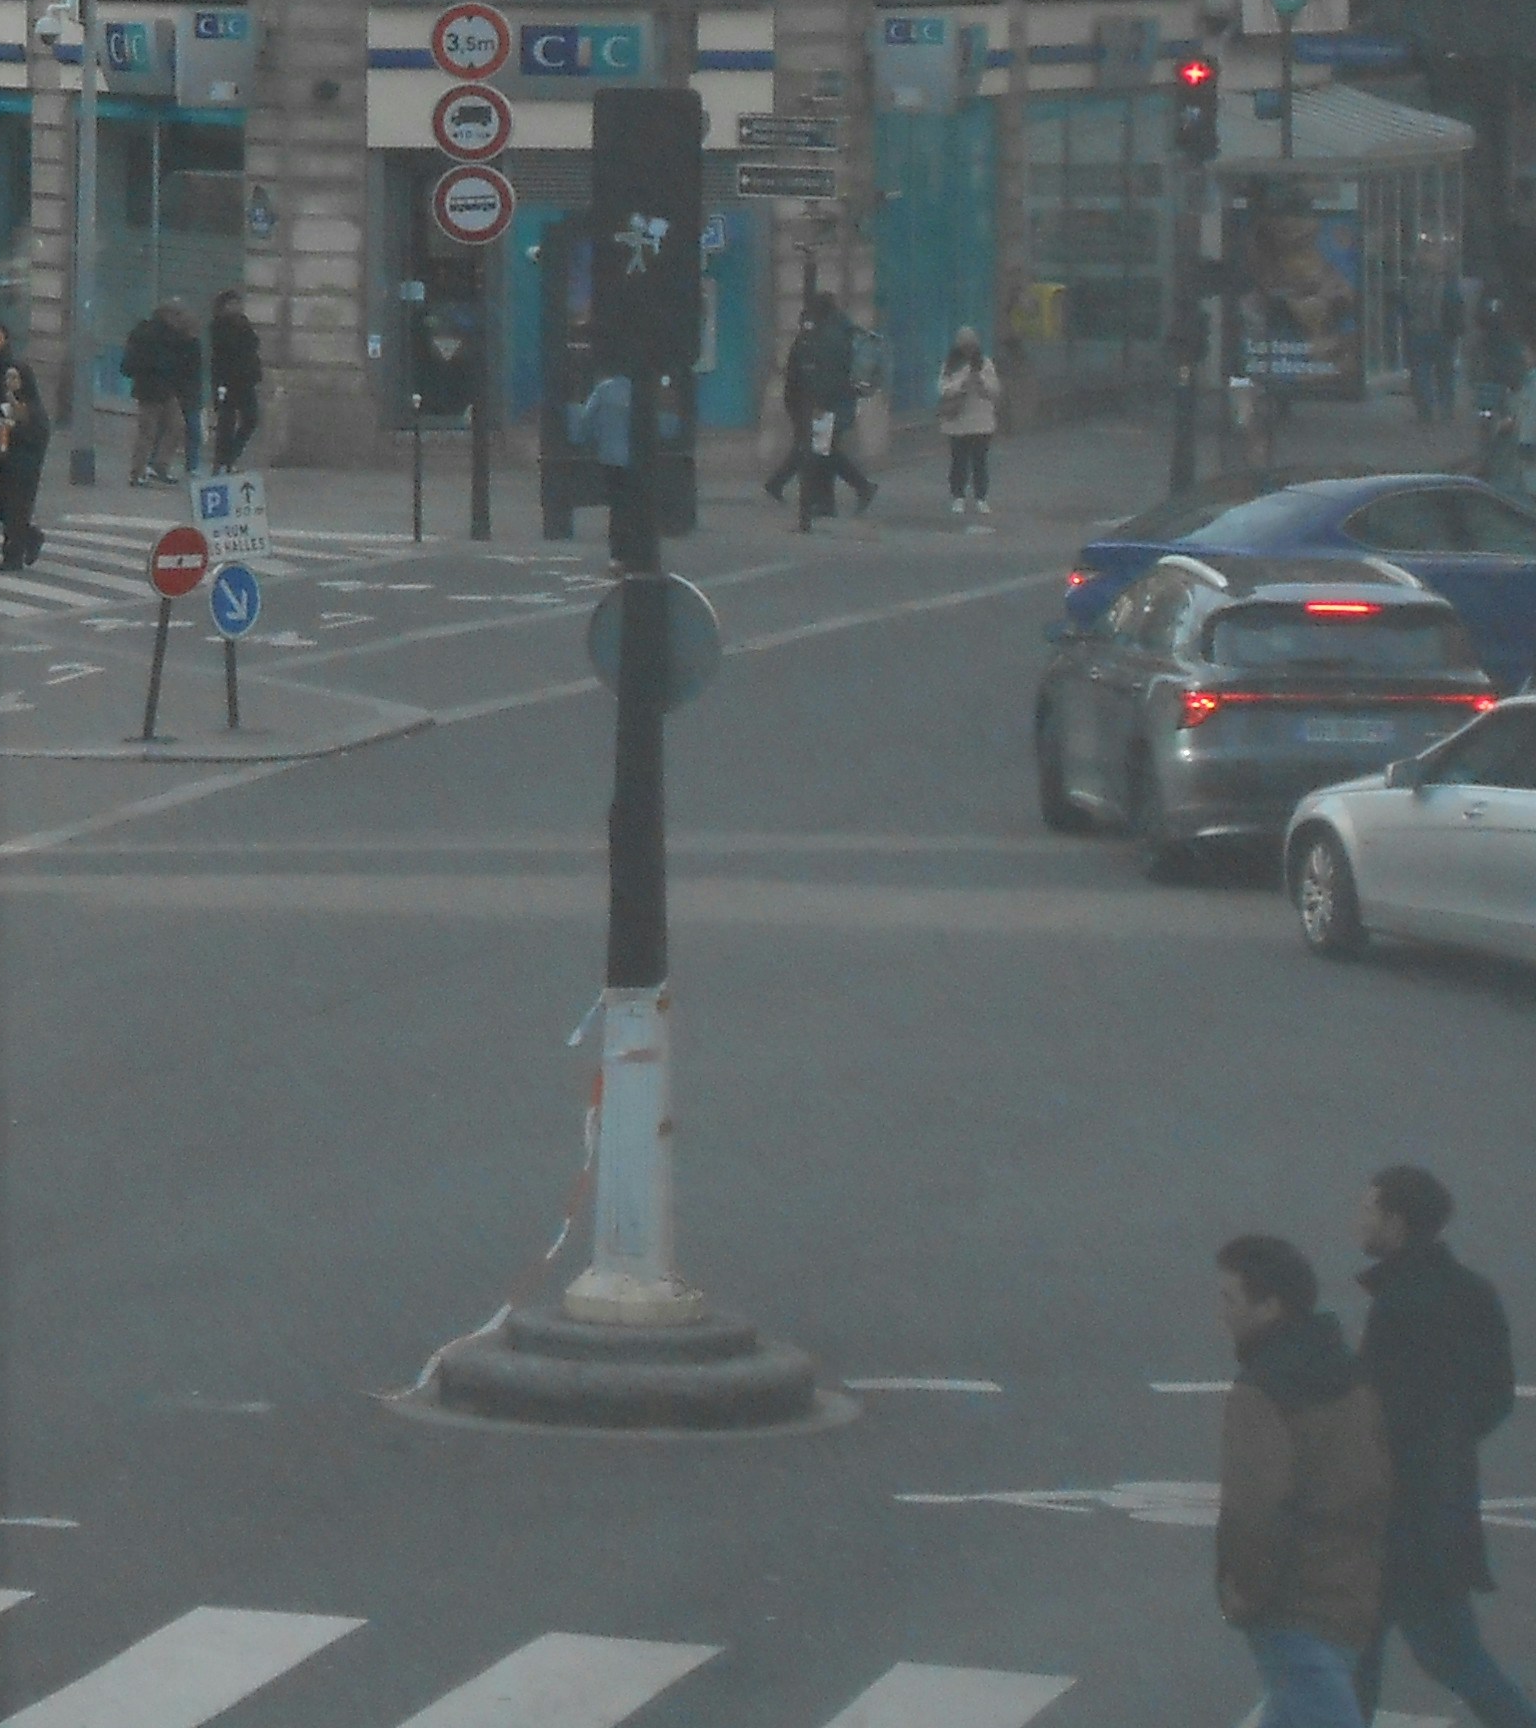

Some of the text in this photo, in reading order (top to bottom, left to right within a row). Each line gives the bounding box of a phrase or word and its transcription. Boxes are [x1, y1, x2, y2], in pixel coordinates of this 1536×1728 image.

[199, 18, 241, 35] CIC
[890, 23, 938, 40] CIC
[111, 33, 147, 63] CIC
[533, 35, 630, 68] CIC
[207, 491, 221, 514] P
